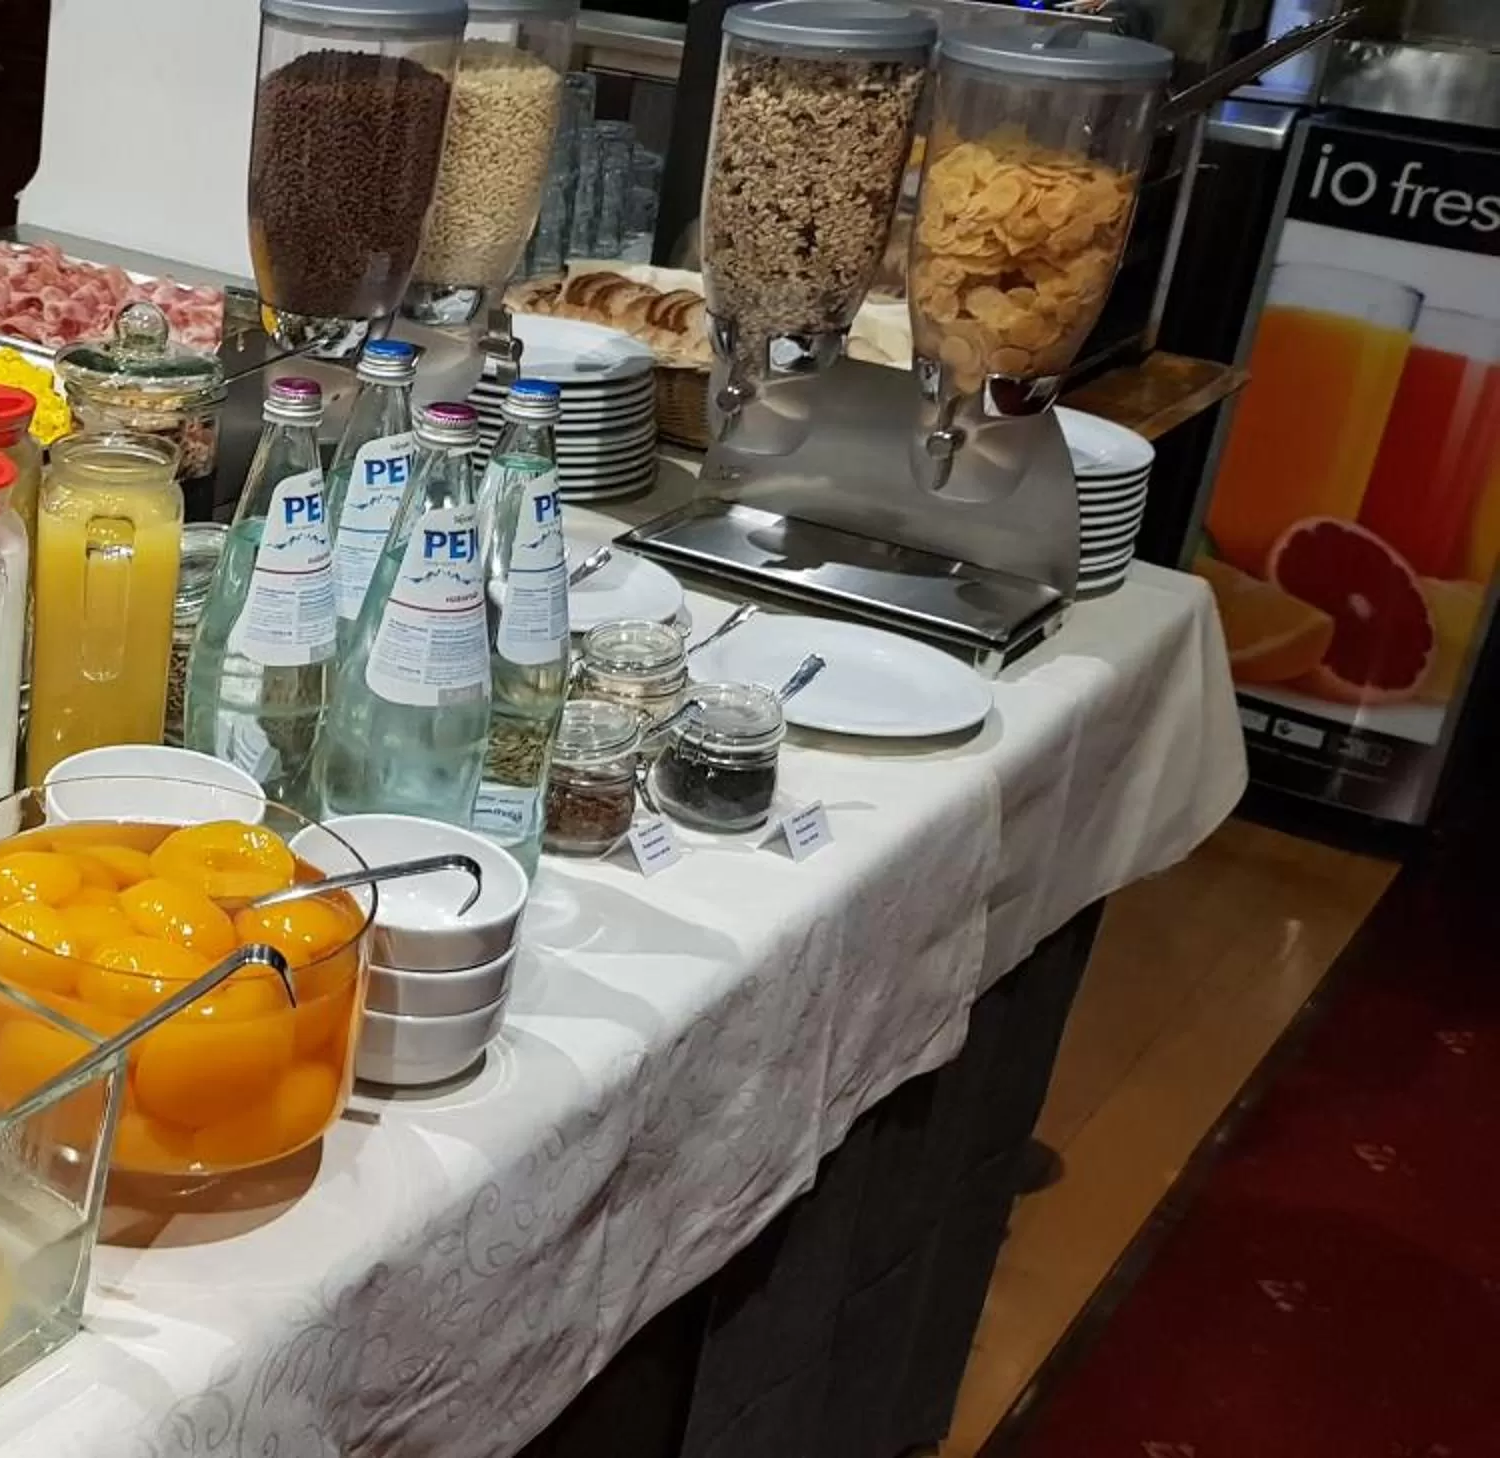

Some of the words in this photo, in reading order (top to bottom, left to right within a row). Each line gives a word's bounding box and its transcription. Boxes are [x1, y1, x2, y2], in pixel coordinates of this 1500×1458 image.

[1309, 143, 1378, 207] io
[1389, 161, 1500, 232] fres
[282, 490, 325, 524] PE
[423, 525, 479, 564] PEJ
